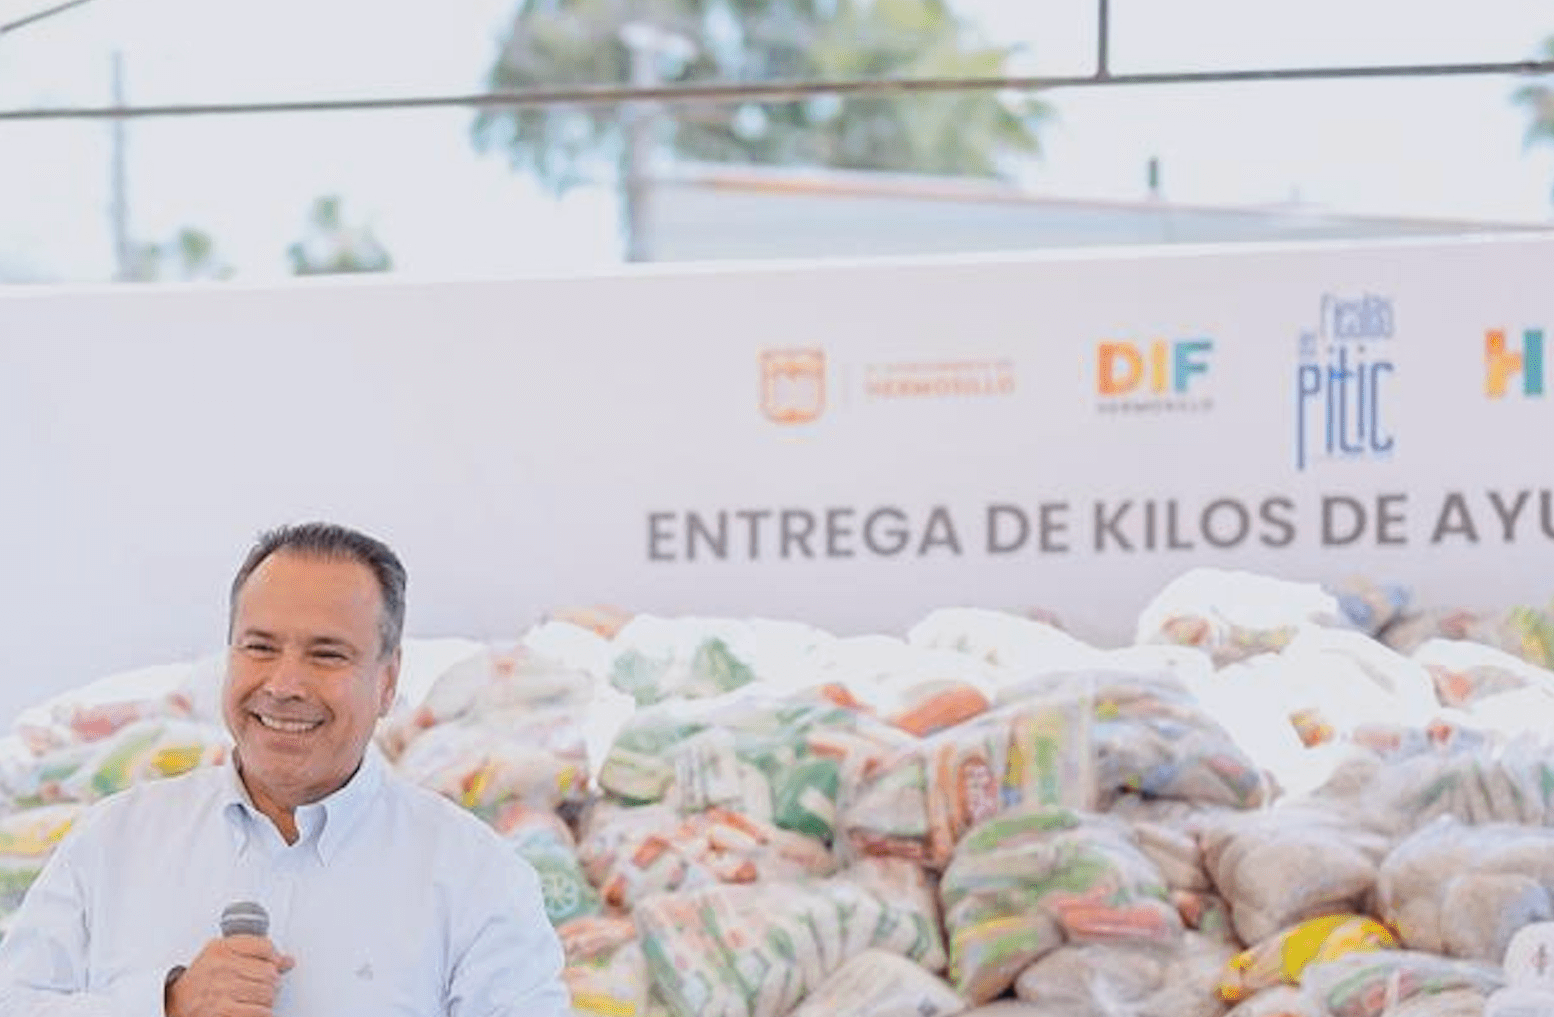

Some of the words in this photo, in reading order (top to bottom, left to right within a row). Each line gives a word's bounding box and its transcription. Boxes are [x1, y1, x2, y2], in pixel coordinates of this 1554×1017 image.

[1097, 341, 1214, 397] DIF
[649, 504, 963, 562] ENTREGA
[986, 502, 1071, 555] DE
[1093, 495, 1298, 553] KILOS
[1320, 493, 1410, 548] DE
